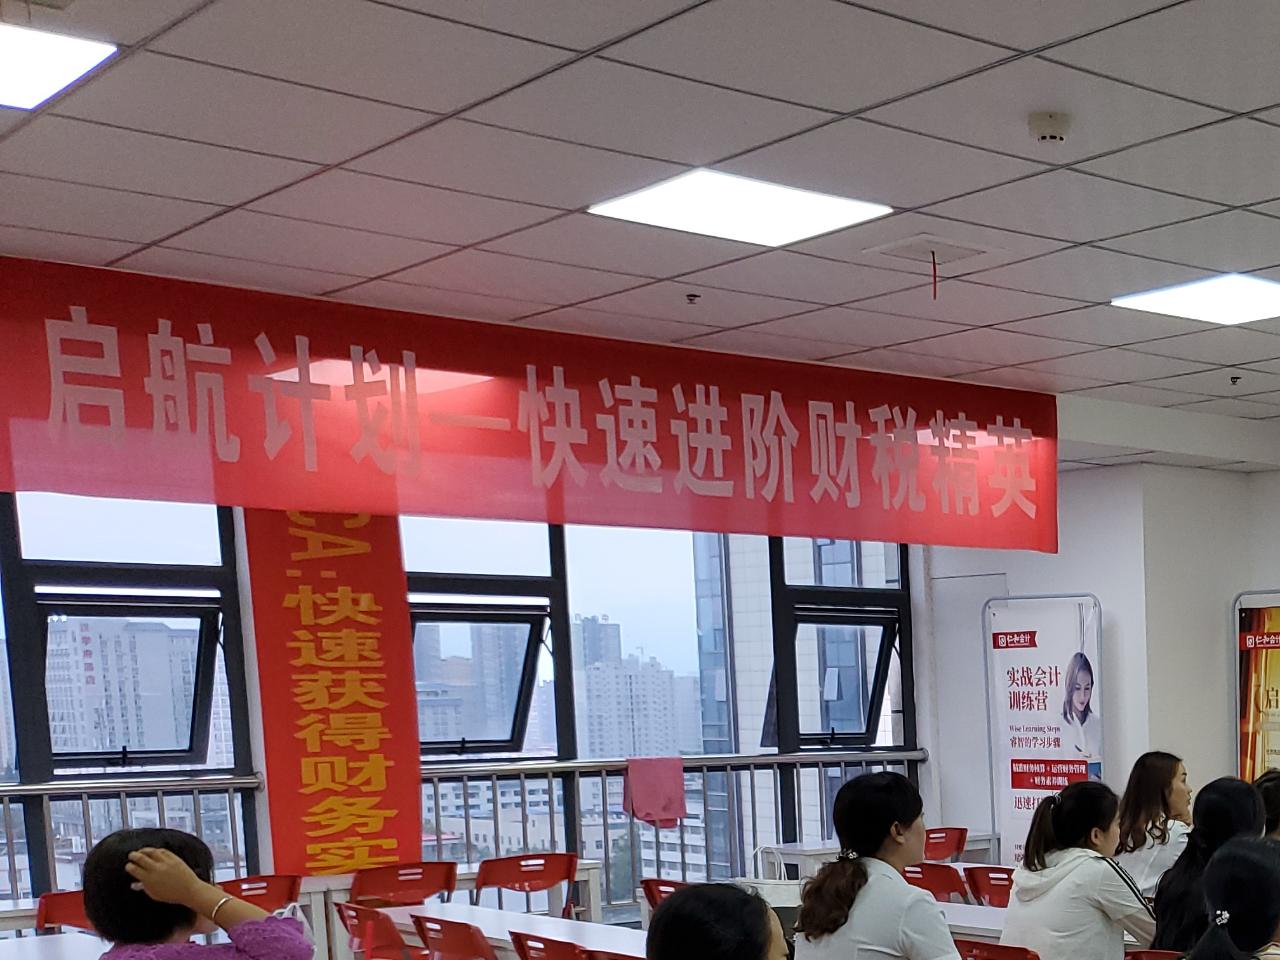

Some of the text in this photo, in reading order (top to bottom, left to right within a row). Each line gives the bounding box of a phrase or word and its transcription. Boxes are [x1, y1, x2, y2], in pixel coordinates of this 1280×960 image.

[1006, 665, 1061, 688] 实战会计
[1008, 690, 1049, 712] 训练营
[1009, 725, 1061, 735] Wise Learning Steps
